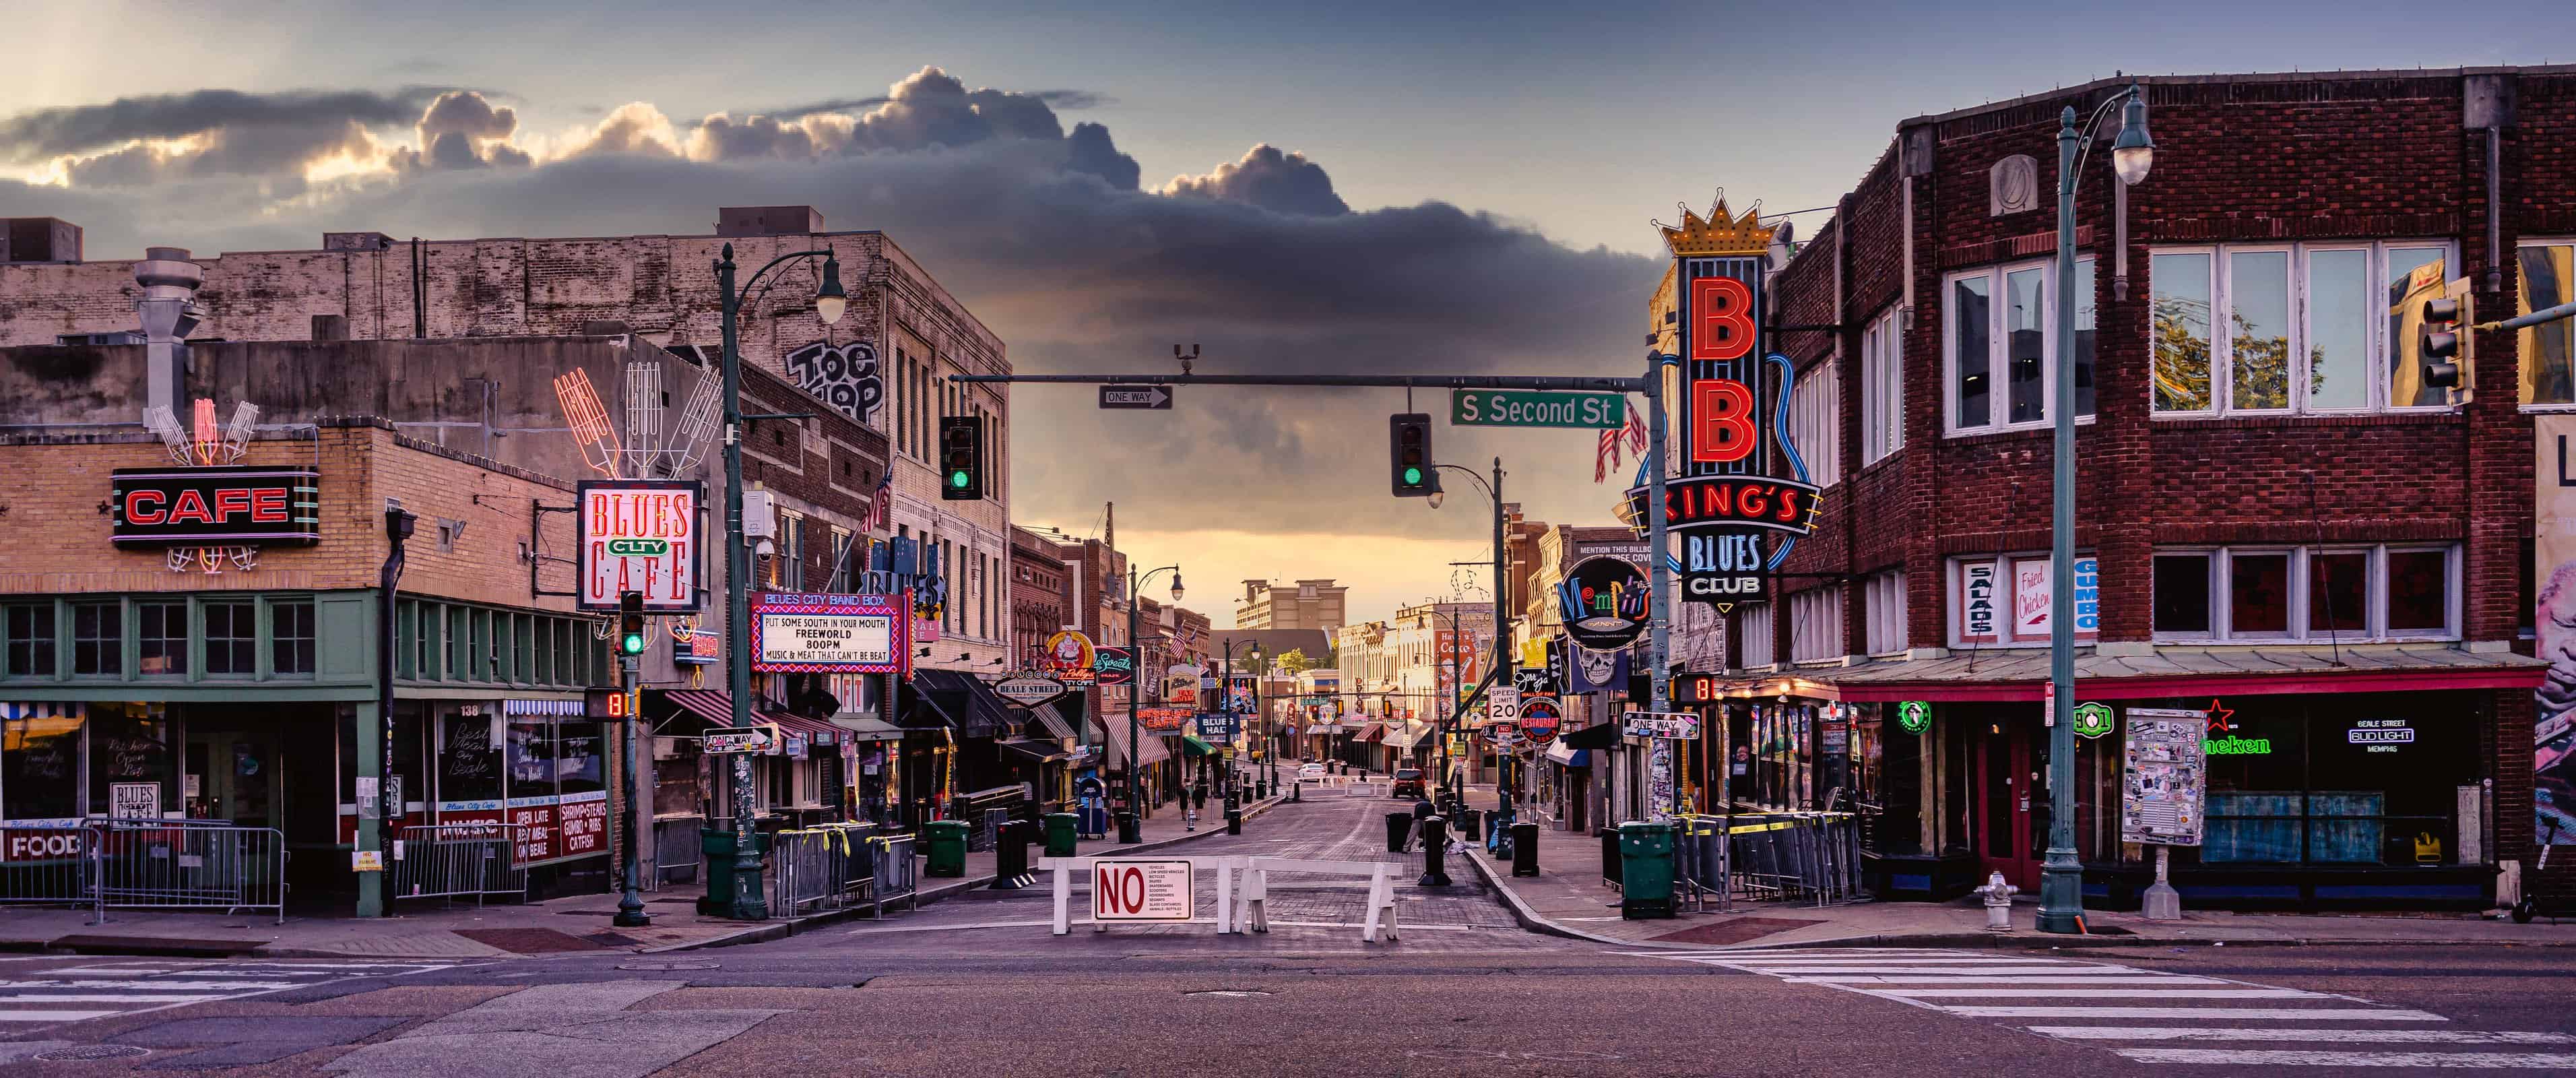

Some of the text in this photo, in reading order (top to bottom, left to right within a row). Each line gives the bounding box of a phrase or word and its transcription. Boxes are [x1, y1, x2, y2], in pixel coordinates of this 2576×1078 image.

[1692, 277, 1756, 360] B
[1108, 393, 1151, 402] ONE WAY
[1462, 394, 1615, 424] S. Second St.
[1693, 379, 1757, 462] B
[126, 488, 288, 525] CAFE
[591, 494, 688, 538] BLUES
[613, 541, 665, 552] CITY
[1689, 535, 1760, 571] BLUES
[1689, 577, 1760, 594] CLUB
[2022, 565, 2045, 591] Fried
[765, 594, 886, 605] BLUES CITY BAND BOX
[1970, 567, 1993, 633] SALADS
[2075, 560, 2098, 629] GUMBO
[2019, 592, 2050, 619] Chicken
[766, 618, 885, 628] PUT SOME SOUTH IN YOUR MOUTH
[796, 629, 851, 639] FREEWORLD
[806, 641, 840, 649] 800PM
[766, 651, 787, 659] MUSIC
[798, 651, 815, 659] MEAT
[818, 652, 835, 660] THAT
[837, 652, 857, 660] CAN'T
[870, 652, 887, 660] BEAT
[1697, 679, 1708, 699] 13
[461, 705, 478, 716] 138
[609, 695, 621, 716] 13
[1493, 705, 1515, 717] 20
[1147, 717, 1180, 728] CAFE
[1521, 717, 1559, 728] RESTAURANT
[1634, 720, 1677, 730] ONE WAY
[734, 735, 752, 744] WAY
[2352, 731, 2411, 740] BUD LIGHT
[2203, 736, 2271, 755] neken
[117, 786, 154, 804] BLUES
[517, 811, 548, 825] OPEN LATE
[532, 827, 548, 840] MEAL
[565, 818, 602, 836] GUMBO RIBS
[530, 843, 547, 857] BEALE
[570, 834, 594, 850] CATFISH
[1100, 866, 1145, 914] NO
